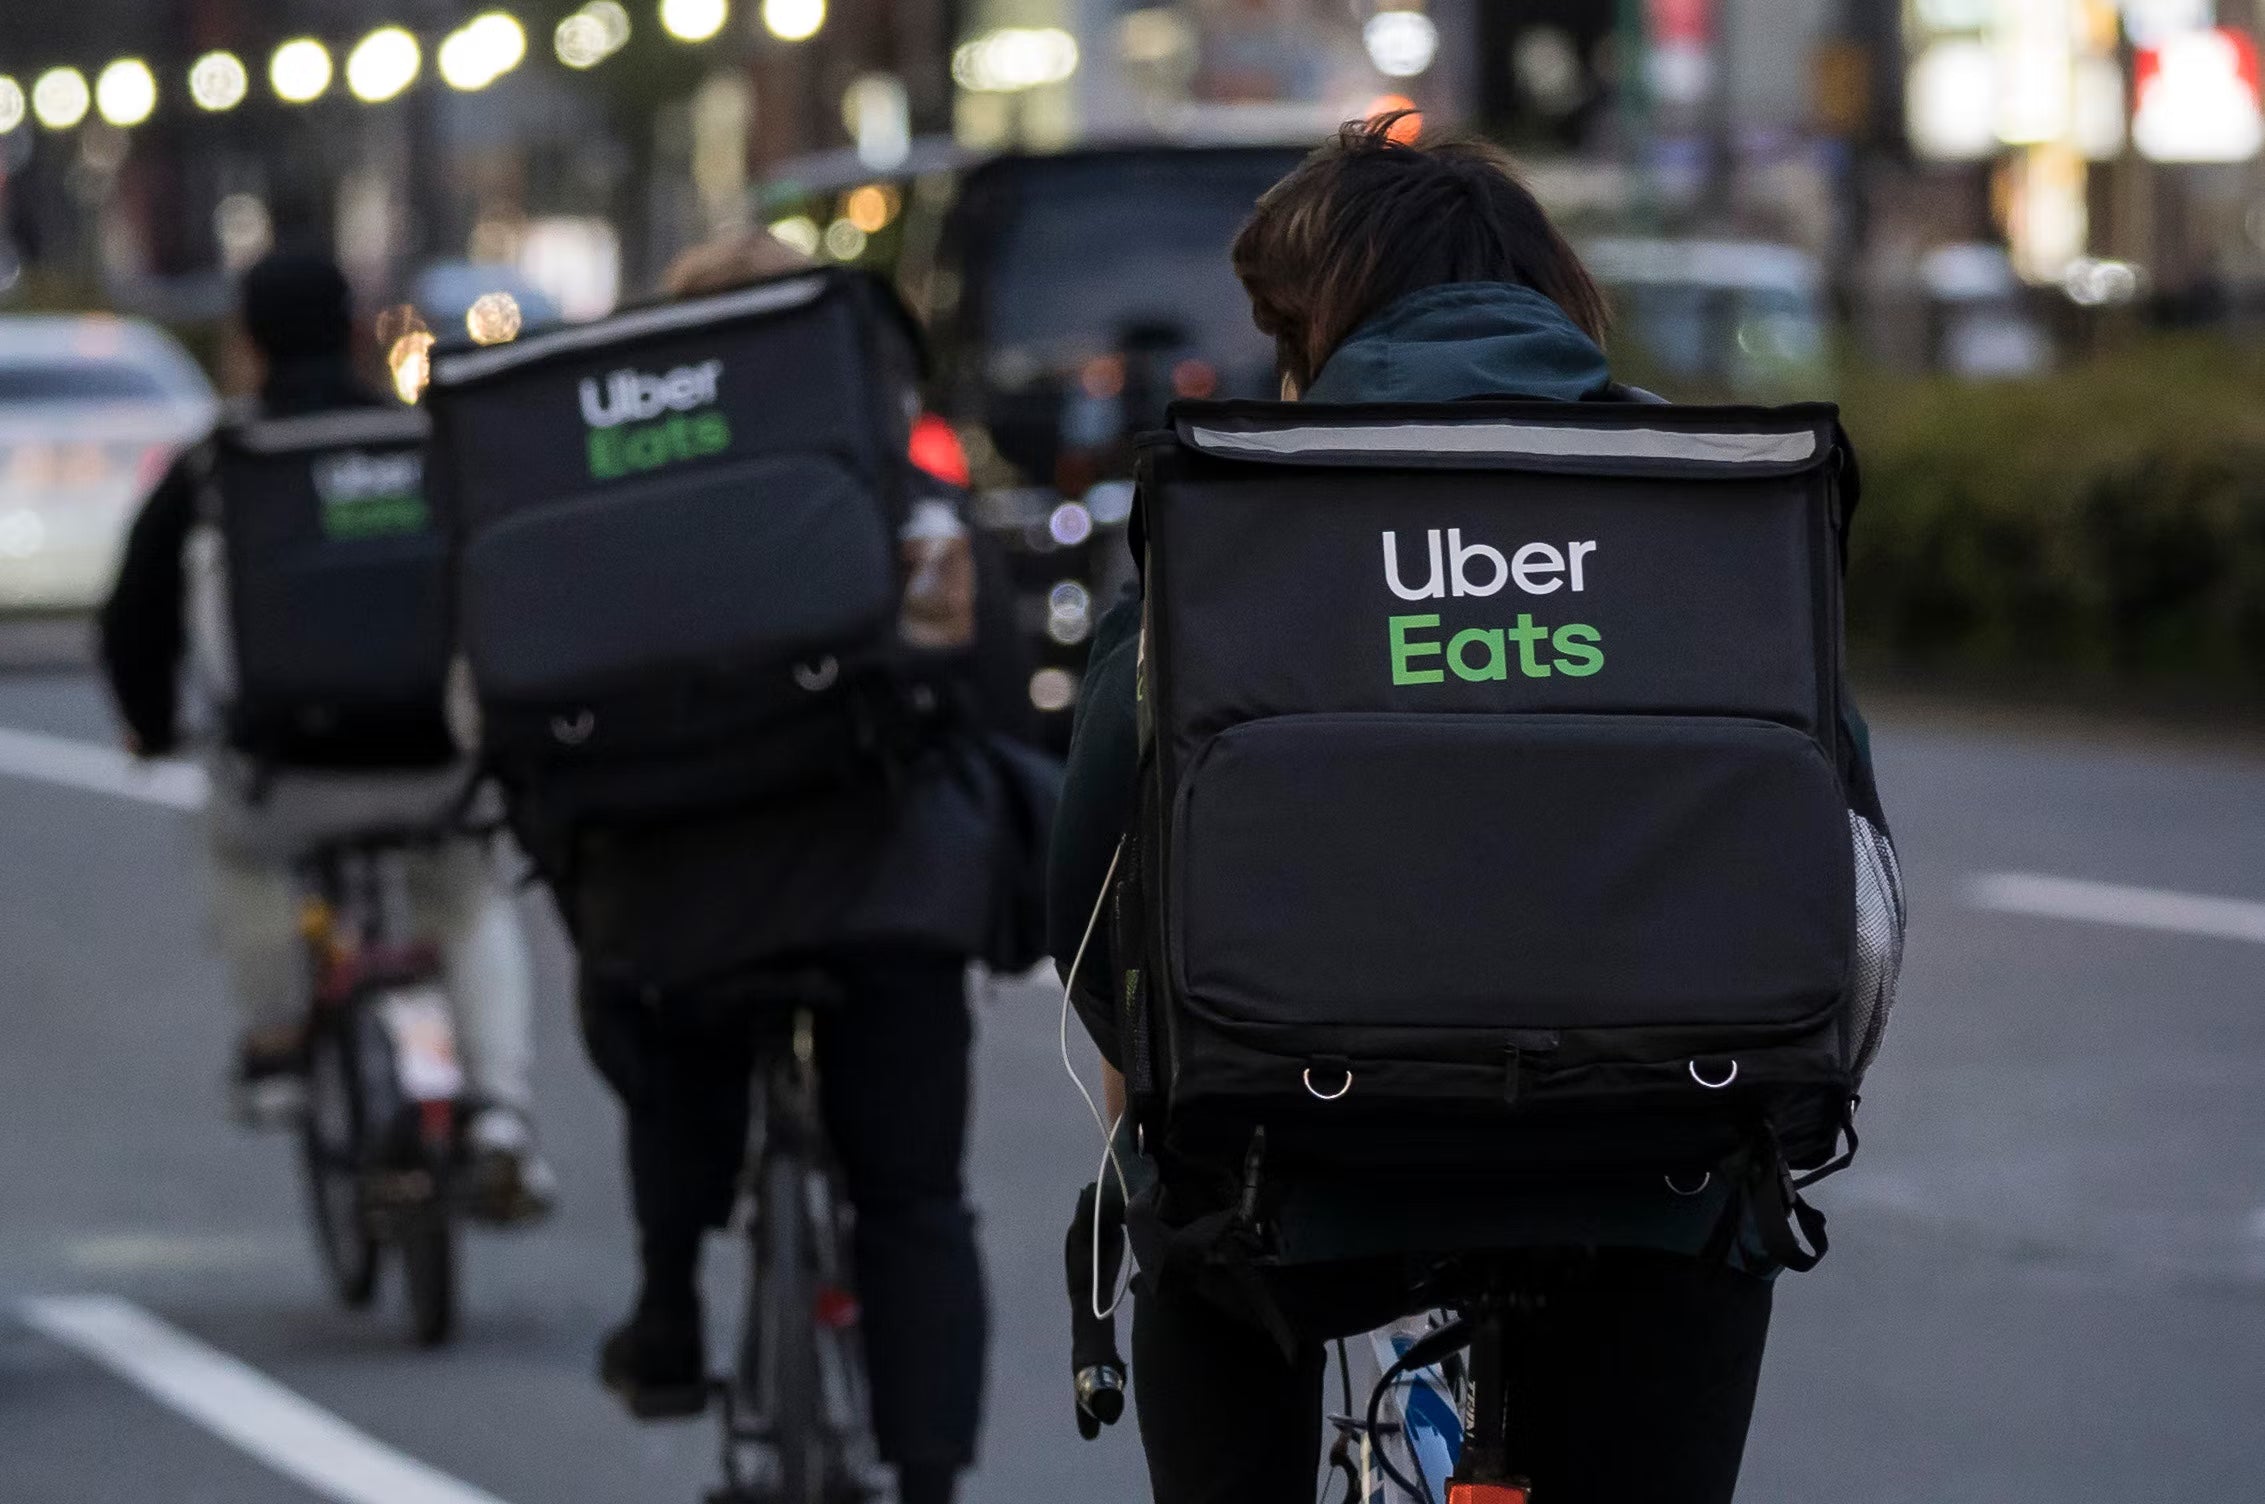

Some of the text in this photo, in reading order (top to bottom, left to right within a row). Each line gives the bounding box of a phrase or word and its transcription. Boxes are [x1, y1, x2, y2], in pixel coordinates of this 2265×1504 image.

[579, 359, 722, 428] Uber
[1382, 527, 1597, 601] Uber
[1389, 613, 1604, 685] Eats
